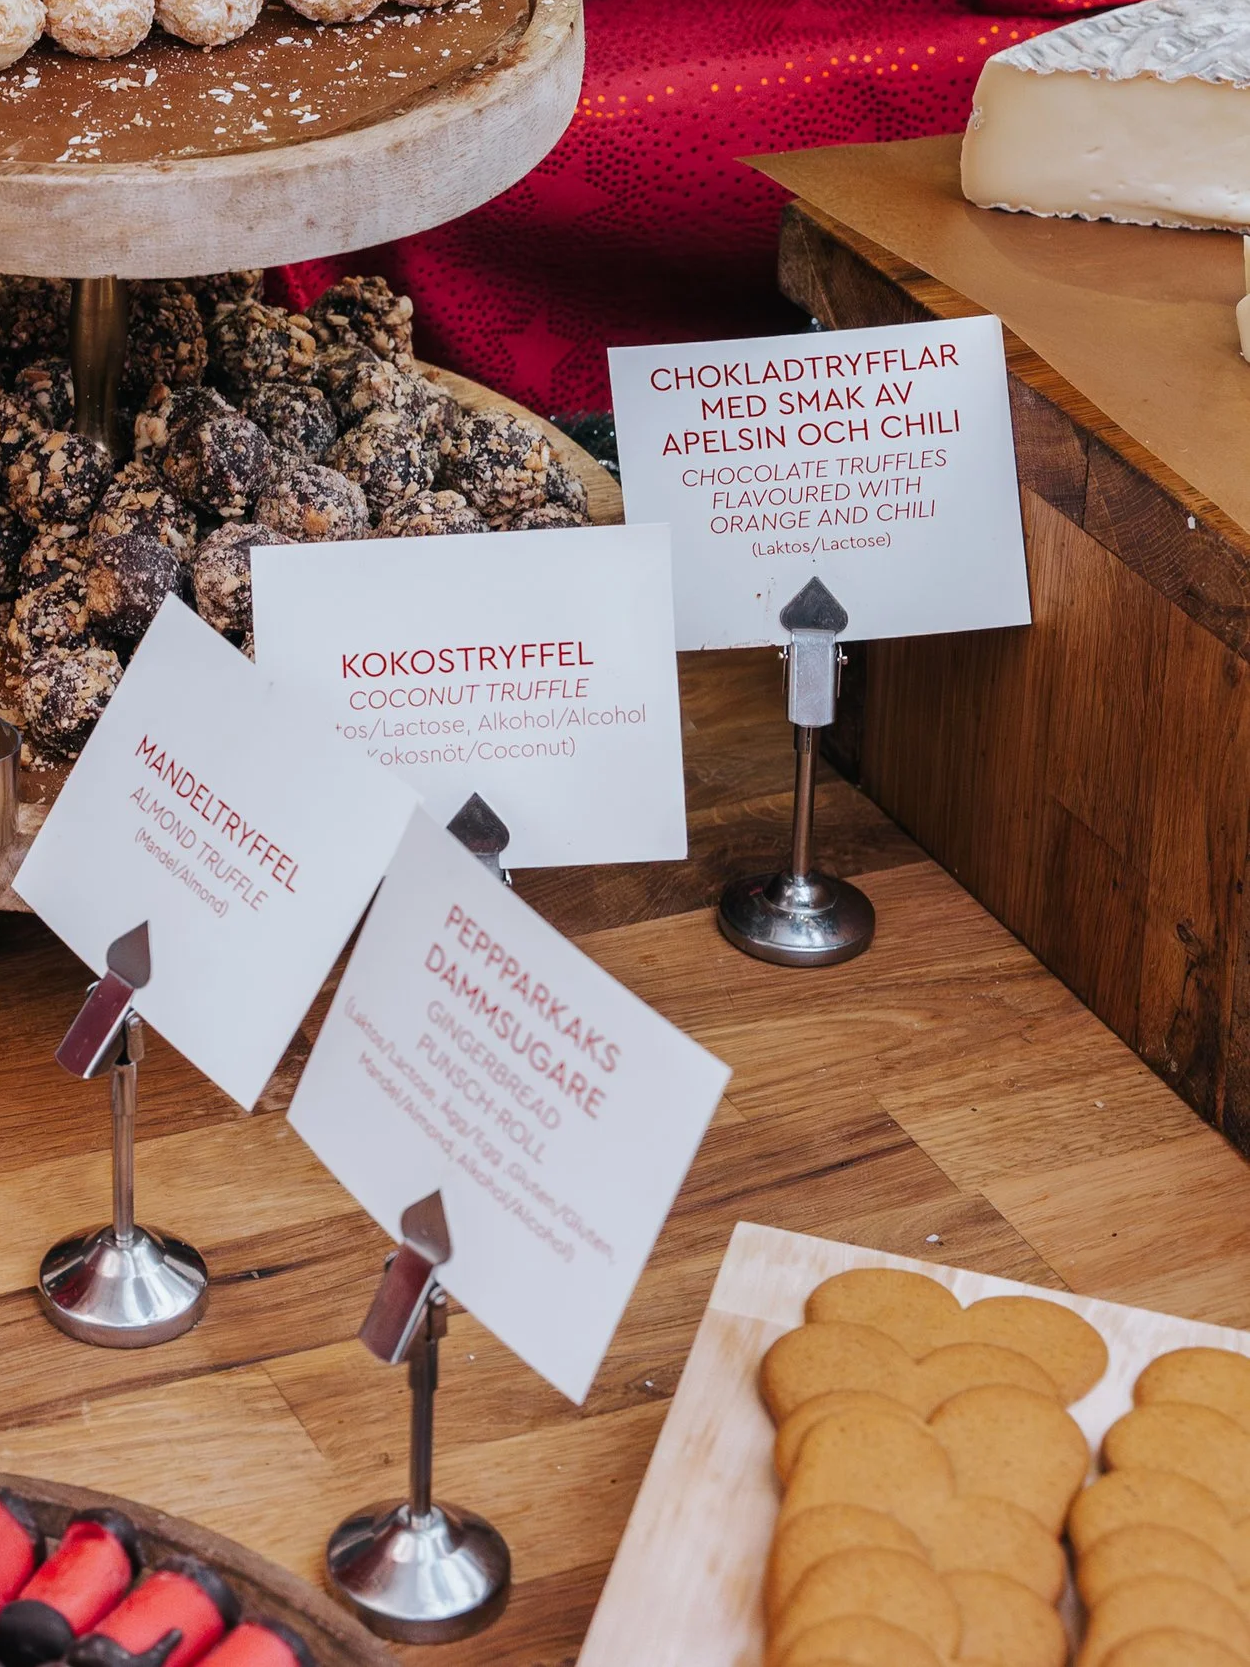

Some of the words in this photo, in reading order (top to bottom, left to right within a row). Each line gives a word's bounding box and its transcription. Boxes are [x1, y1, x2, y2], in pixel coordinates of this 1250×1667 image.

[650, 343, 959, 392] CHOKLADTRYFFLAR
[701, 395, 767, 421] MED
[778, 387, 865, 414] SMAK
[875, 380, 913, 407] AV
[662, 426, 786, 456] APELSIN
[797, 419, 869, 447] OCH
[880, 409, 960, 439] CHILI
[682, 460, 828, 488] CHOCOLATE
[836, 448, 947, 477] TRUFFLES
[712, 483, 850, 510] FLAVOURED
[858, 476, 922, 499] WITH
[710, 511, 810, 535] ORANGE
[817, 505, 868, 527] AND
[876, 499, 935, 523] CHILI
[751, 532, 891, 558] (Laktos/Lactose)
[342, 641, 594, 679] KOKOSTRYFFEL
[350, 684, 480, 710] COCONUT
[486, 678, 589, 704] TRUFFLE
[478, 704, 646, 731] Alkohol/Alcohol
[135, 734, 299, 894] MANDELTRYFFEL
[129, 786, 197, 849] ALMOND
[197, 841, 269, 911] TRUFFLE
[134, 827, 230, 919] (Mandel/Almond)
[424, 942, 606, 1120] DAMMSUGARE
[426, 999, 562, 1130] GINGERBREAD
